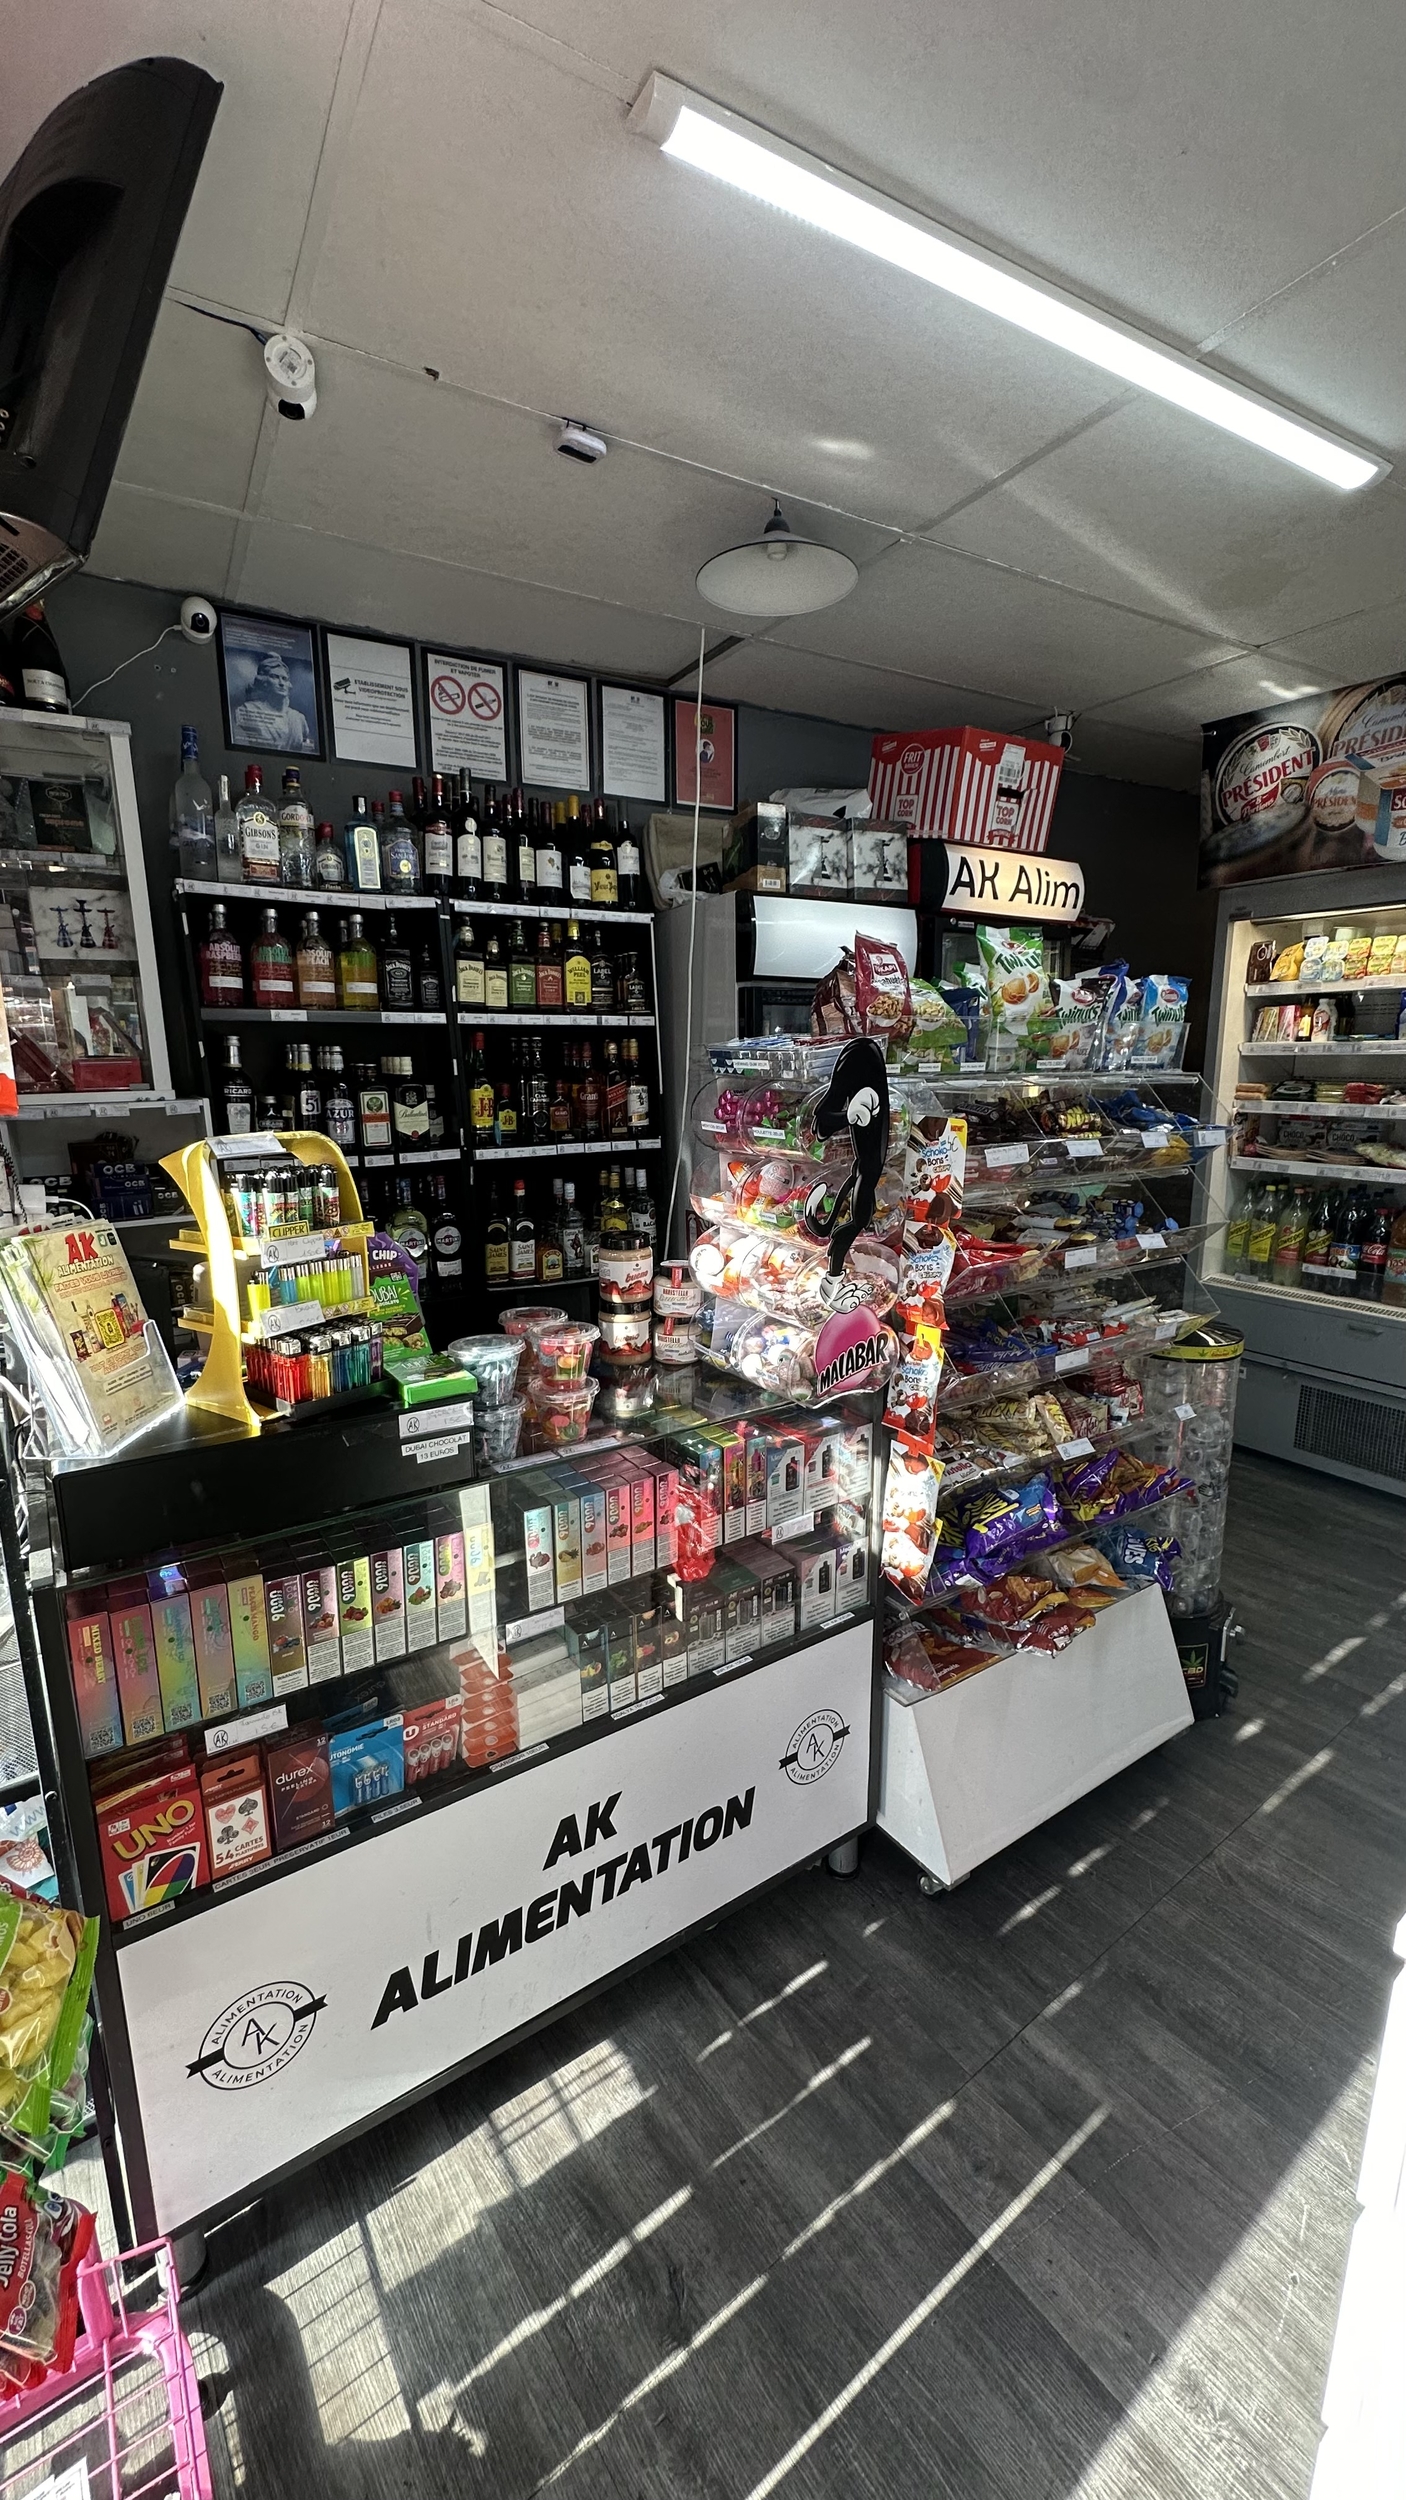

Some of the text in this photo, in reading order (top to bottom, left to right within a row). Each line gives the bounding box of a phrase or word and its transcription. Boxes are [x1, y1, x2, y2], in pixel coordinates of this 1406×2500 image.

[904, 751, 922, 761] FRIT
[1239, 745, 1291, 776] Camembert
[1221, 747, 1315, 808] PRÉSIDENT
[897, 809, 913, 817] CORN
[899, 800, 914, 810] TOP
[997, 806, 1014, 818] TOP
[949, 856, 1080, 910] AK Alim
[209, 943, 241, 951] ABSOLUT
[307, 957, 329, 966] PEACH
[593, 967, 612, 975] LABEL
[224, 1087, 251, 1095] RICARD
[304, 1097, 320, 1112] 51
[326, 1108, 355, 1119] AZUR
[103, 1163, 136, 1174] OCB
[927, 1157, 944, 1168] Bons
[125, 1180, 146, 1188] OCB
[158, 1191, 179, 1200] OCB
[272, 1225, 305, 1238] CLIPPER
[65, 1232, 99, 1264] AK
[372, 1250, 397, 1261] CHIP
[57, 1255, 114, 1277] ALIMENTATION
[625, 1270, 649, 1283] bueno
[820, 1332, 890, 1393] MALABAR
[405, 1434, 467, 1453] DUBAI CHOCOLAT
[429, 1447, 455, 1458] EUROS
[944, 1460, 973, 1476] nutella
[90, 1624, 101, 1652] MIXED
[421, 1712, 457, 1731] STANDARD
[215, 1732, 228, 1746] AK
[793, 1714, 840, 1749] ALIMENTATION
[316, 1737, 327, 1746] 12
[806, 1733, 825, 1762] AK
[491, 1753, 525, 1771] CHARGEUR
[790, 1744, 840, 1781] ALIMENTATION
[275, 1762, 314, 1786] durex
[322, 1819, 331, 1827] 12
[373, 1809, 393, 1822] PILES
[112, 1800, 196, 1861] UNO
[166, 1829, 183, 1843] Number
[542, 1791, 623, 1870] AK
[169, 1834, 185, 1847] Family
[216, 1836, 264, 1865] 54 CARTES
[214, 1873, 249, 1890] CARTES
[273, 1837, 326, 1864] PRESERVATIF
[326, 1829, 347, 1841] 1EUR
[370, 1786, 756, 2031] ALIMENTATION
[125, 1910, 146, 1928] UNO
[211, 1988, 303, 2045] ALIMENTATION
[241, 2017, 280, 2056] AK
[212, 2023, 309, 2084] ALIMENTATION
[17, 2234, 34, 2279] BOTELLAS
